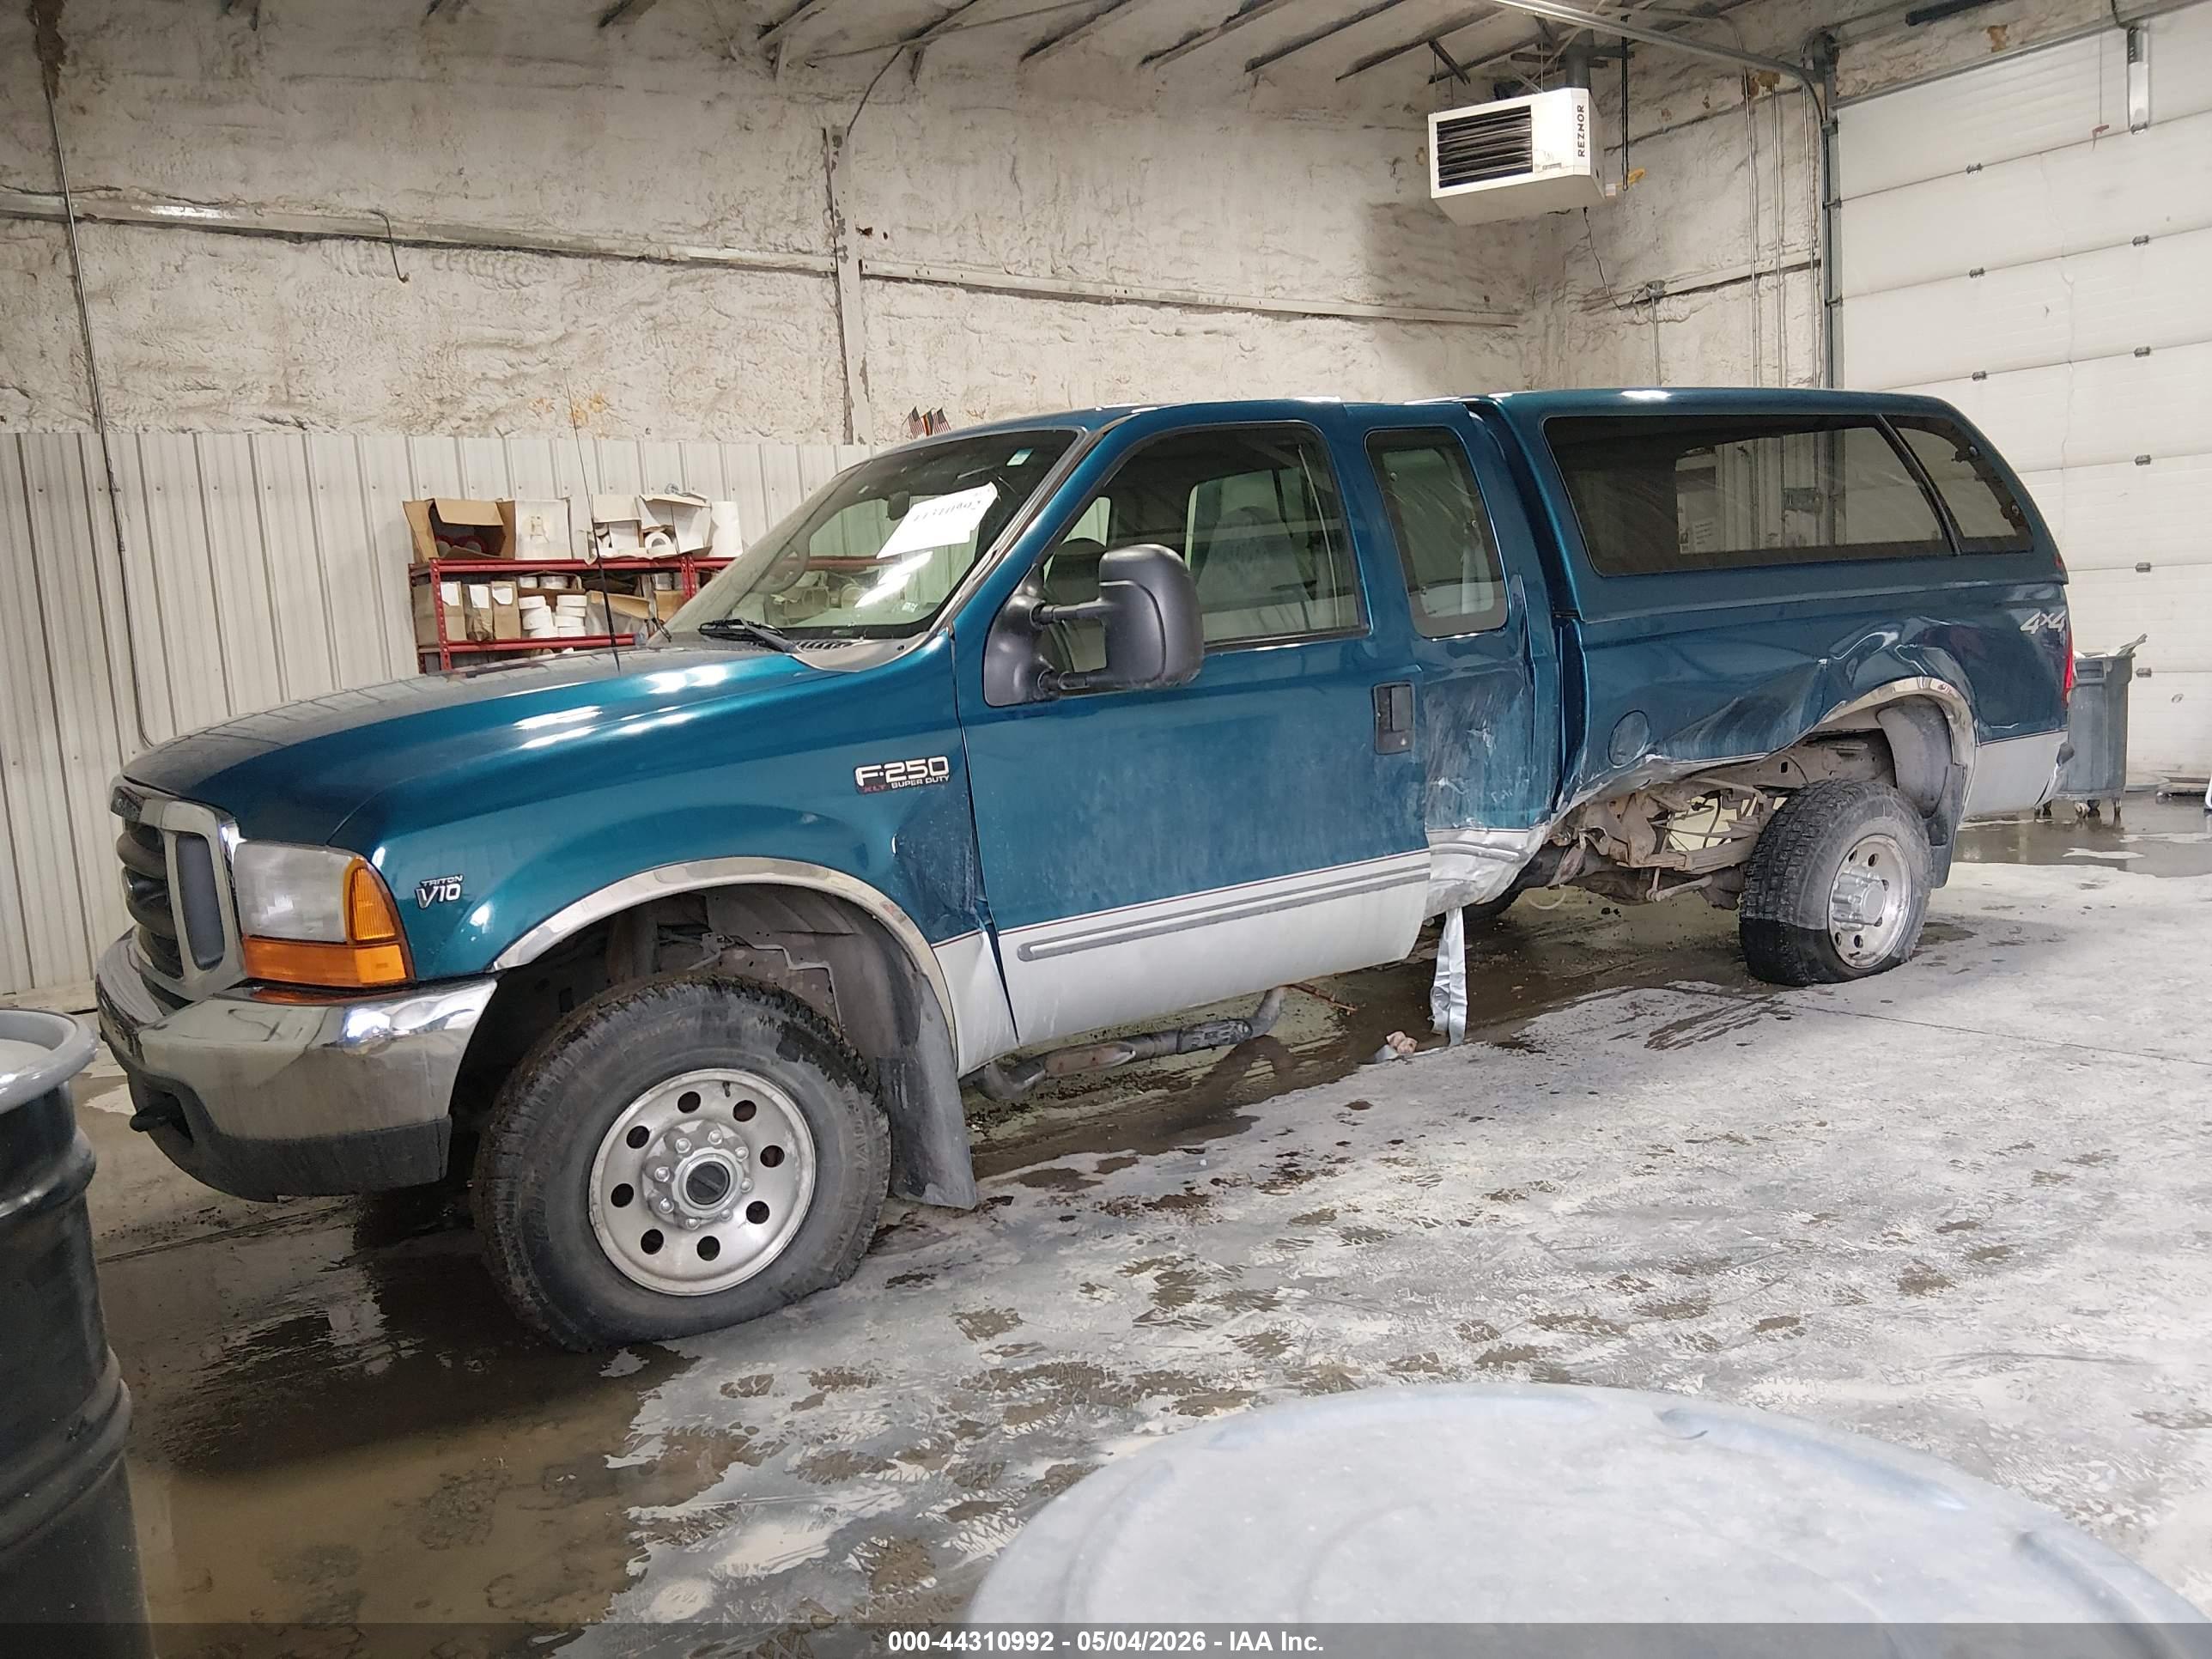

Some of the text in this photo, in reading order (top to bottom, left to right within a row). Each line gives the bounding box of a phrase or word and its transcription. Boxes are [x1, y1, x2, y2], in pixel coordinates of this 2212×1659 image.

[1577, 104, 1585, 158] REZNOR
[890, 775, 951, 789] SUPER DUTY
[421, 874, 464, 887] TRITON
[416, 883, 462, 909] V10
